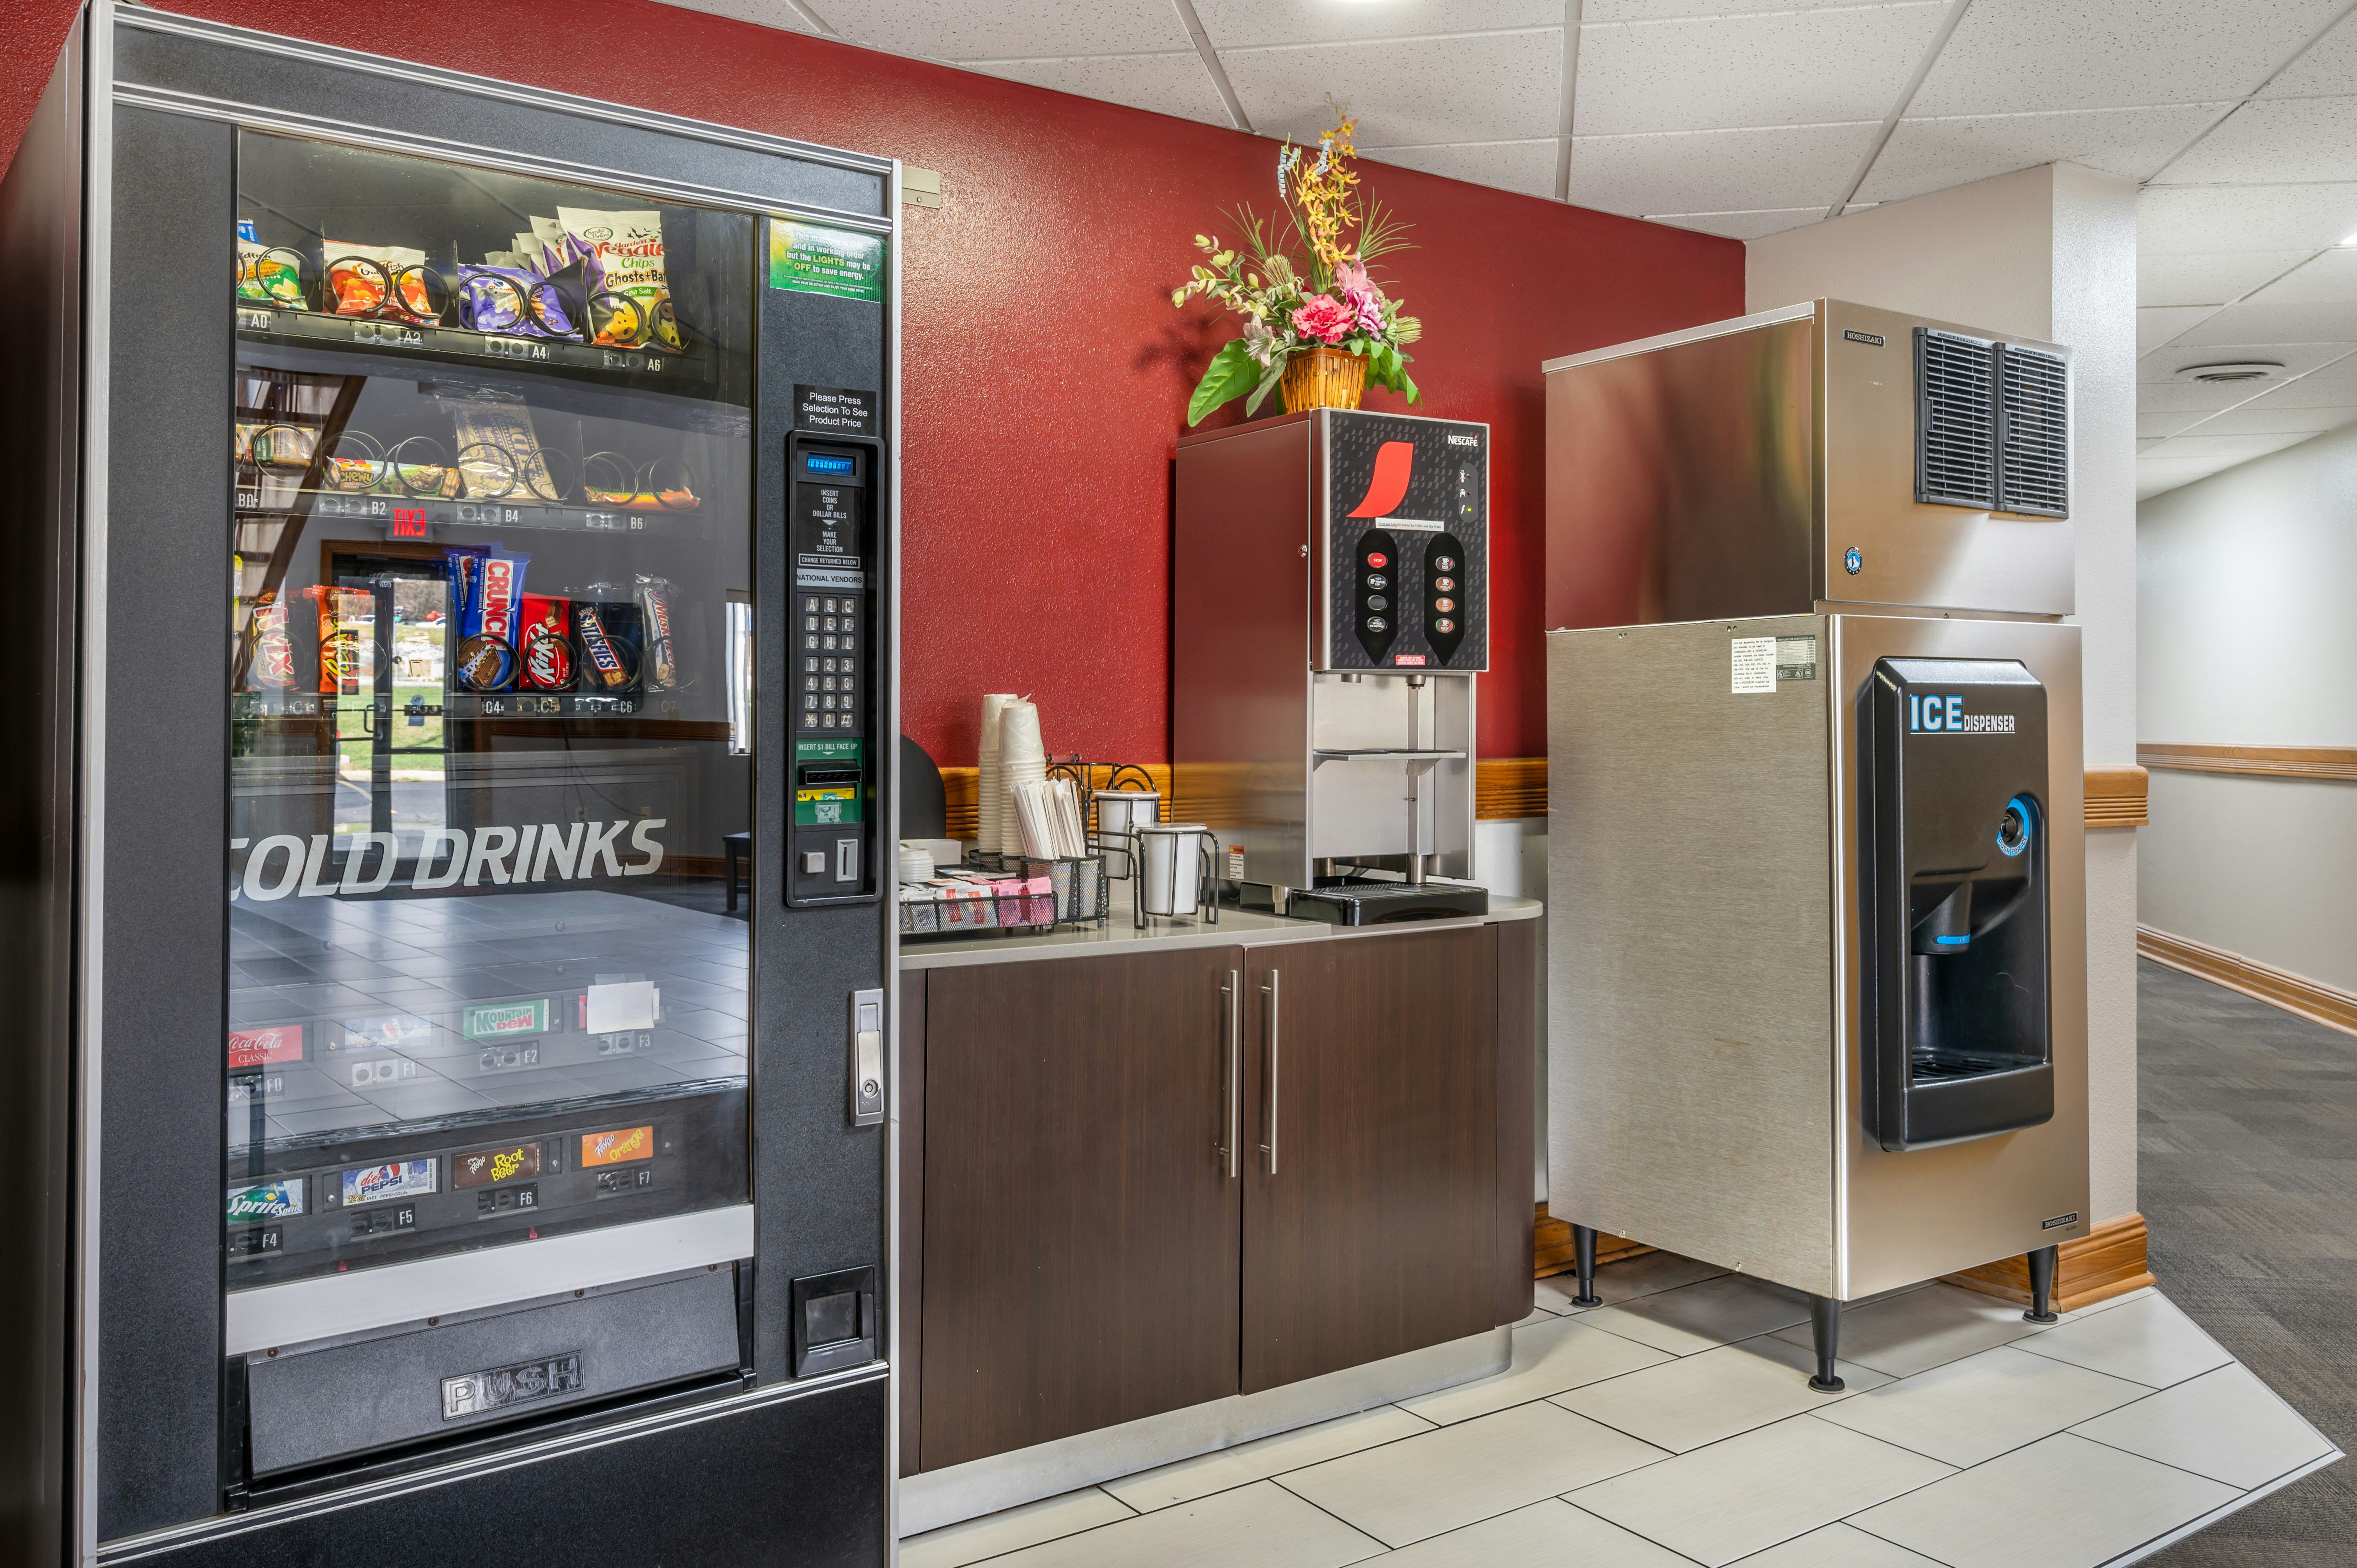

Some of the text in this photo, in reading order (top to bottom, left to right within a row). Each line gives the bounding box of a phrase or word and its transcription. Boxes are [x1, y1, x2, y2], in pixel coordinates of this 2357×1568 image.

[615, 239, 647, 247] garden
[584, 240, 665, 260] Veggie
[816, 246, 845, 257] working
[846, 251, 864, 259] order
[621, 258, 655, 269] Chips
[787, 251, 871, 270] but the LIGHTS may be
[794, 263, 811, 271] OFF
[839, 270, 864, 281] energy.
[606, 270, 665, 288] Ghosts+Bat
[251, 314, 267, 328] A0
[404, 331, 420, 345] A2
[1847, 332, 1882, 344] HOSHIZAKI
[532, 347, 546, 359] A4
[647, 359, 660, 371] A6
[810, 392, 861, 404] Please Press
[803, 403, 868, 417] Selection To See
[809, 415, 861, 427] Product Price
[507, 424, 531, 452] ACT
[239, 494, 253, 507] B0
[372, 502, 386, 515] B2
[505, 509, 518, 522] B4
[631, 517, 643, 530] B6
[651, 590, 666, 602] 3
[485, 562, 510, 646] CRUNCH
[809, 599, 815, 610] A
[827, 600, 832, 610] B
[845, 601, 850, 611] C
[809, 618, 815, 628] D
[827, 618, 832, 629] E
[845, 619, 850, 629] F
[253, 602, 294, 676] TWIX
[809, 636, 814, 646] G
[827, 637, 832, 647] H
[845, 637, 849, 647] J
[809, 659, 813, 669] 1
[827, 659, 831, 669] 2
[845, 660, 849, 670] 3
[808, 678, 813, 687] 4
[827, 678, 831, 688] 5
[844, 678, 849, 688] 6
[486, 702, 499, 713] C4
[620, 702, 632, 713] C6
[808, 696, 813, 706] 7
[826, 696, 831, 706] 8
[844, 696, 849, 706] 9
[1911, 695, 2014, 731] ICE DISPENSER
[826, 715, 830, 725] 0
[1998, 838, 2010, 854] PUSH
[411, 818, 667, 890] DRINKS
[391, 1018, 404, 1038] PEPSI
[229, 1032, 284, 1054] Coca-Cola
[639, 1034, 650, 1048] F3
[239, 1052, 272, 1063] CLASSIC
[525, 1050, 537, 1063] F2
[404, 1063, 415, 1076] F1
[267, 1078, 282, 1093] F0
[595, 1134, 615, 1157] Faygo
[610, 1129, 644, 1161] Orange
[470, 1157, 486, 1174] Faygo
[494, 1149, 524, 1169] Root
[360, 1170, 387, 1187] diet
[491, 1163, 519, 1181] Beer
[639, 1171, 650, 1185] F7
[362, 1176, 402, 1195] PEPSI
[228, 1195, 279, 1216] Sprite
[520, 1192, 532, 1206] F6
[276, 1204, 302, 1216] Sprite
[399, 1210, 412, 1225] F5
[2045, 1215, 2075, 1228] HOSHIZAKI
[263, 1233, 277, 1248] F4
[450, 1358, 578, 1413] PUSH
